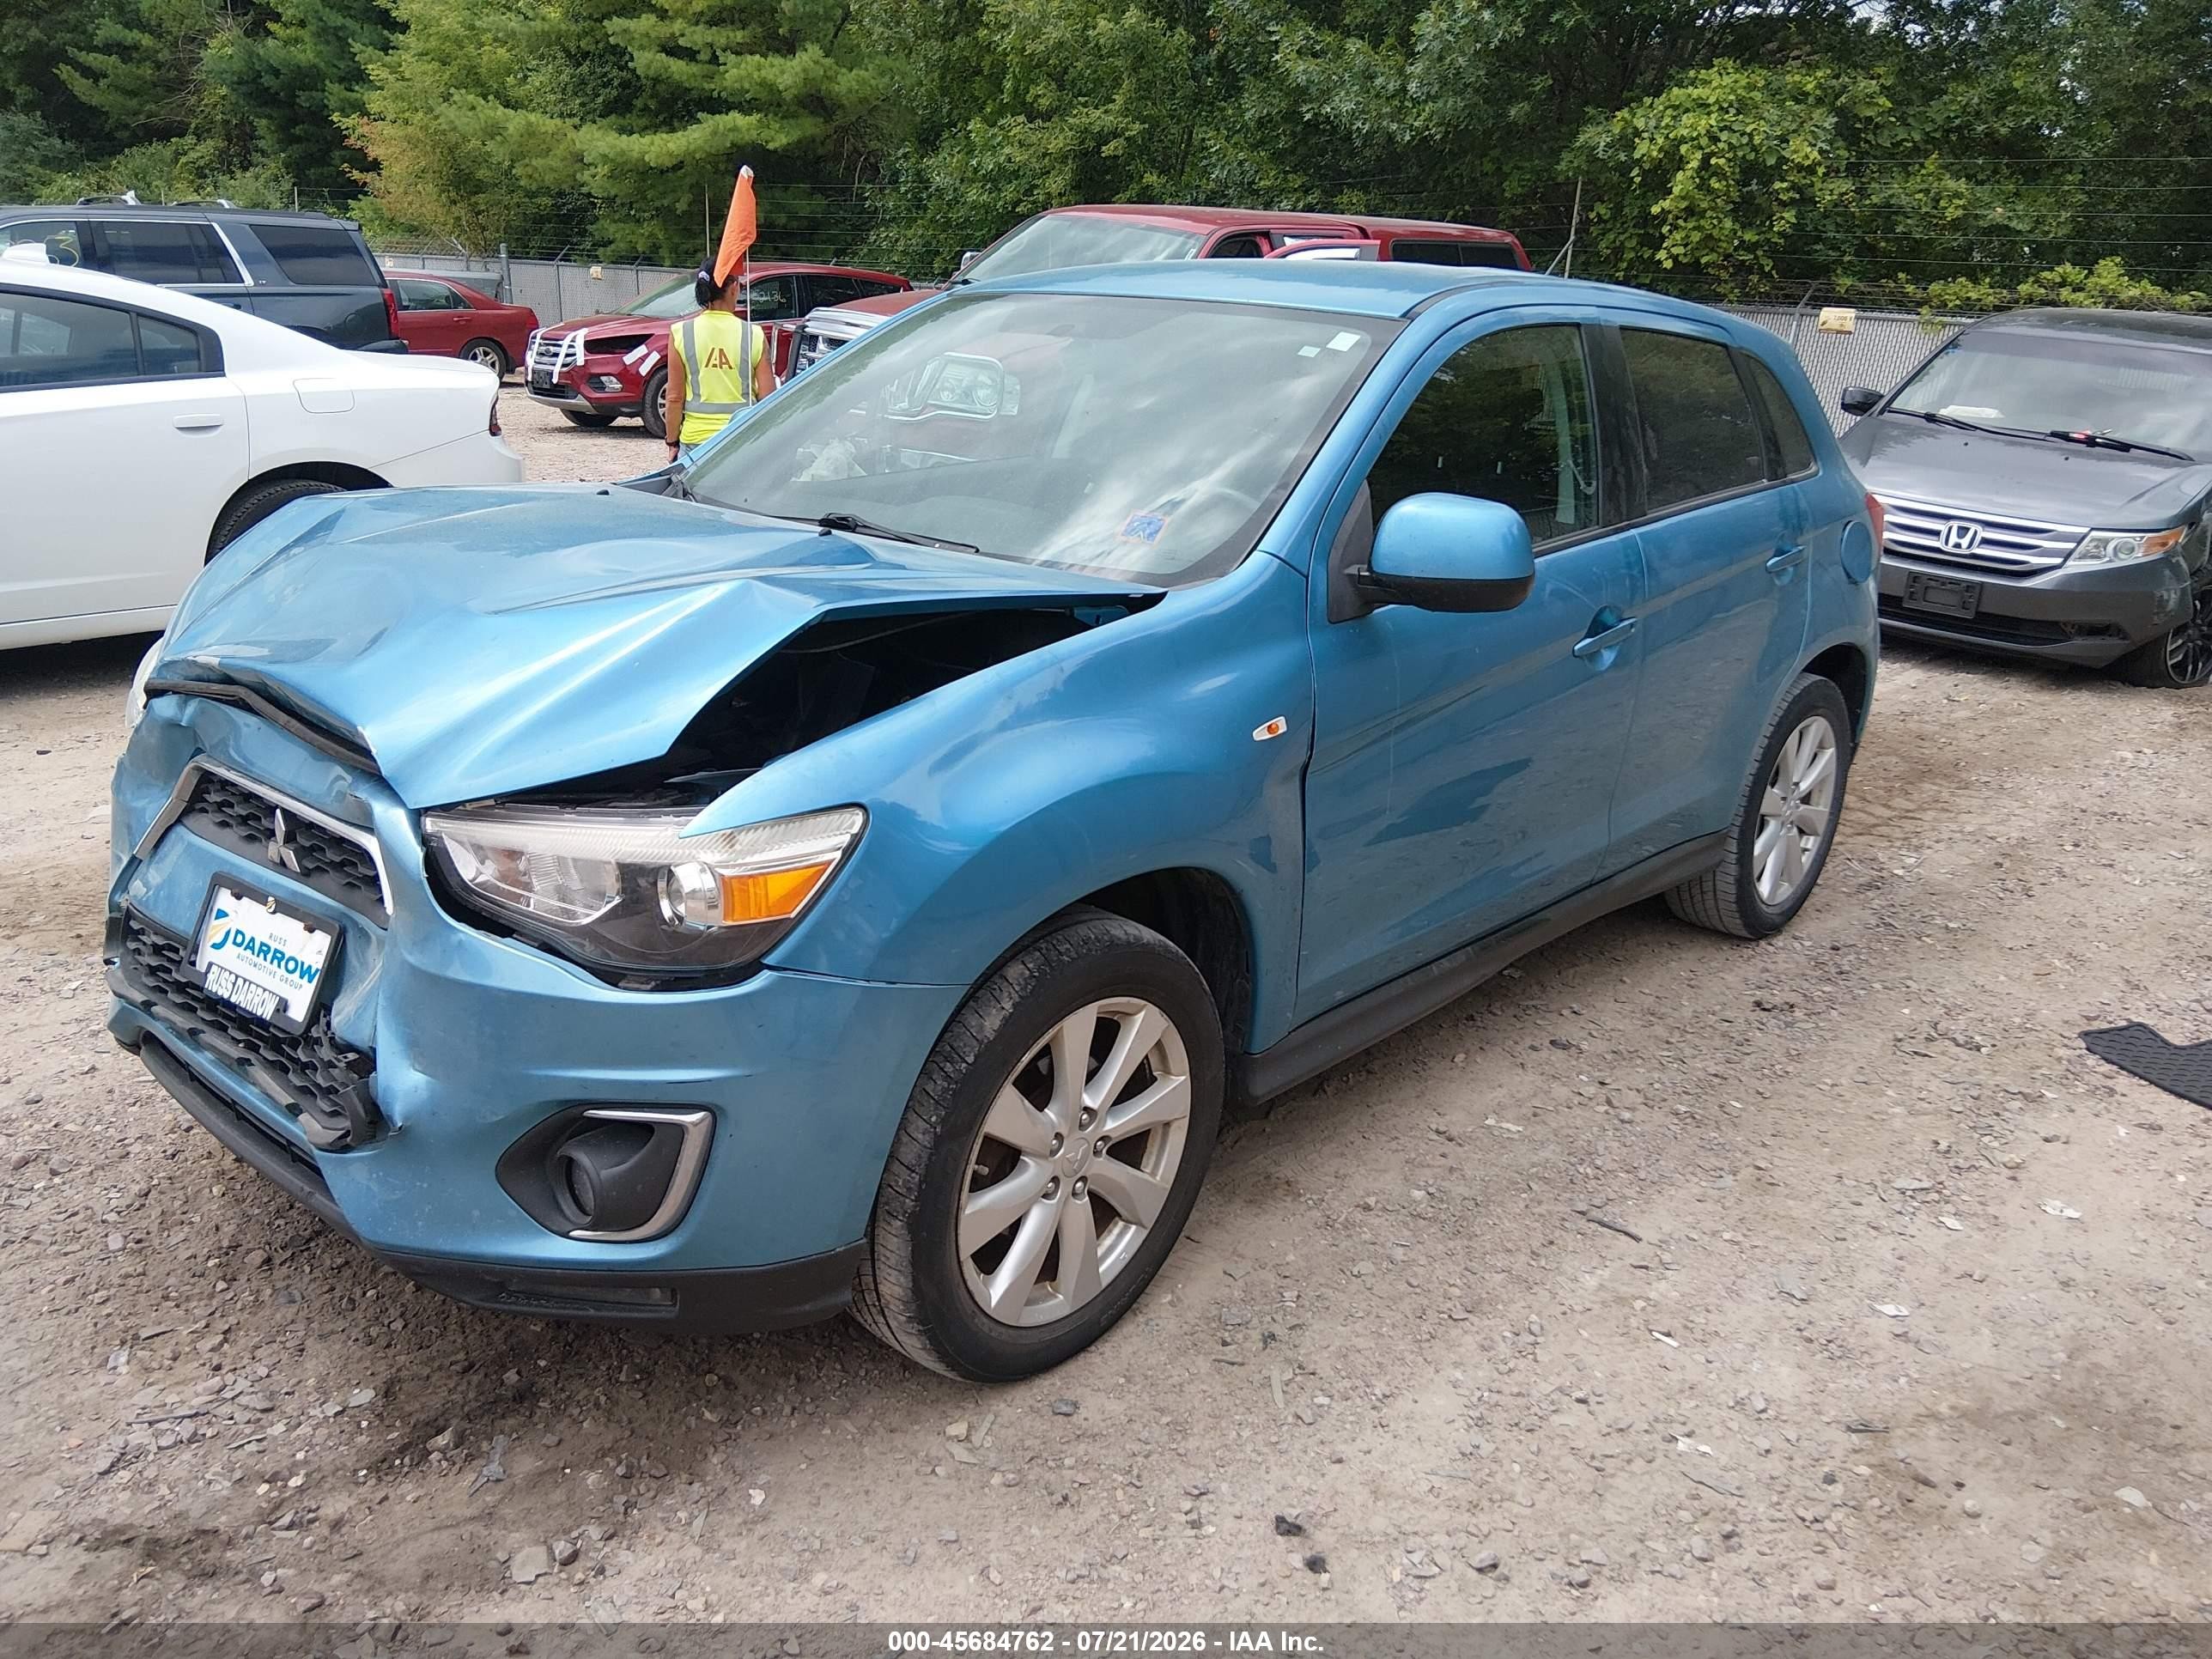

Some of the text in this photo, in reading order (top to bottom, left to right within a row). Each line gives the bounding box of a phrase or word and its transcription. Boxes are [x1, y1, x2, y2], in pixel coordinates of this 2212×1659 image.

[232, 927, 320, 984] DARROW
[268, 932, 288, 946] RUSS
[204, 963, 280, 1021] RUSS DARROW
[236, 952, 303, 991] AUTOMOTIVE GROUP
